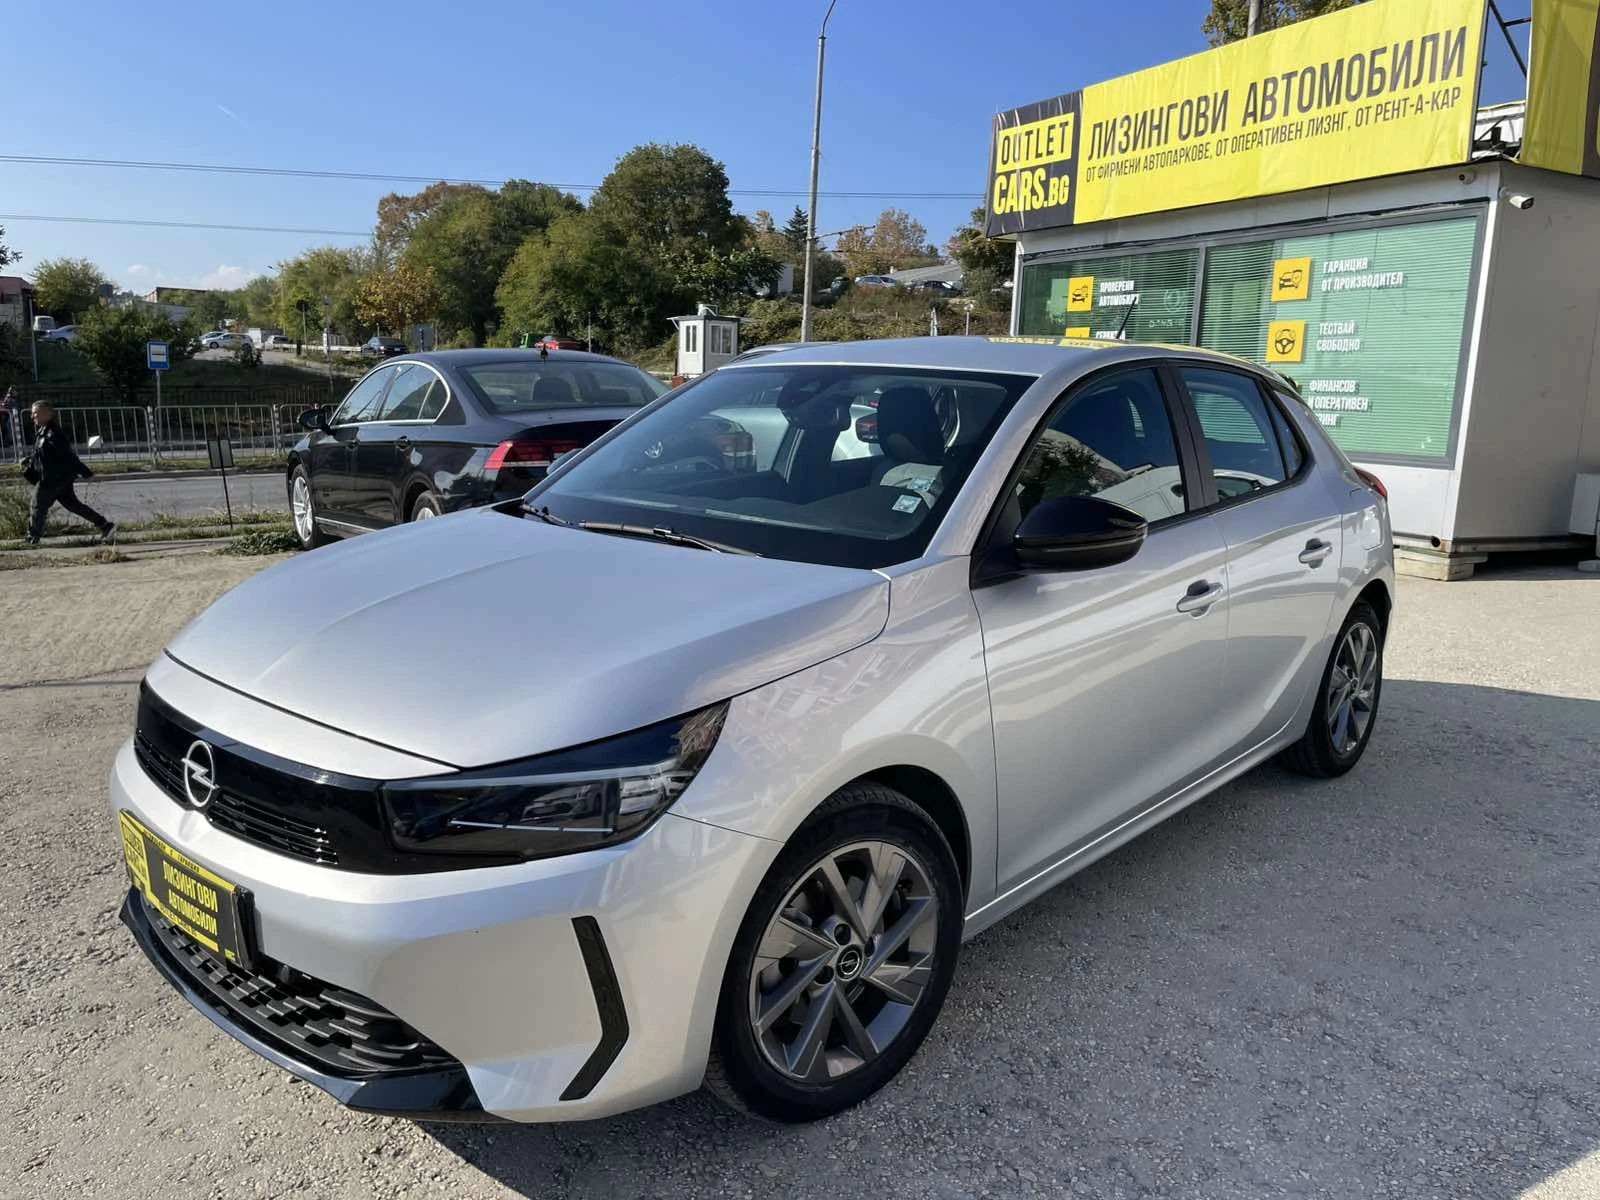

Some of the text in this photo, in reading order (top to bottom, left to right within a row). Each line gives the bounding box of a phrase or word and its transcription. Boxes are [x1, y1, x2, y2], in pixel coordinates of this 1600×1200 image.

[1088, 26, 1467, 161] ЛИЗИНГОВИ АВТОМОБИЛИ
[1001, 121, 1069, 165] OUTLET
[1086, 166, 1097, 183] ОТ
[1098, 158, 1141, 180] ФИРМЕНИ
[1143, 142, 1213, 172] АВТОПАРКОВЕ,
[1216, 137, 1230, 157] ОТ
[1231, 121, 1303, 154] ОПЕРАТИВЕН
[1355, 105, 1373, 128] ОТ
[1374, 86, 1461, 124] РЕНТ-А-КАР
[993, 167, 1070, 215] CARS.BG
[1323, 257, 1368, 273] ГАРАНЦИЯ
[1100, 280, 1135, 292] ПРОВЕРЕНИ
[1321, 272, 1404, 291] ОТ ПРОИЗВОДИТЕЛ
[1319, 319, 1355, 335] ТЕСТВАЙ
[1316, 338, 1361, 352] СВОБОДНО
[1309, 379, 1356, 393] ФИНАНСОВ
[1314, 395, 1368, 411] ОПЕРАТИВЕН
[163, 860, 219, 913] ЛИЗИНГОВИ
[168, 889, 218, 936] АВТОМОБИЛИ
